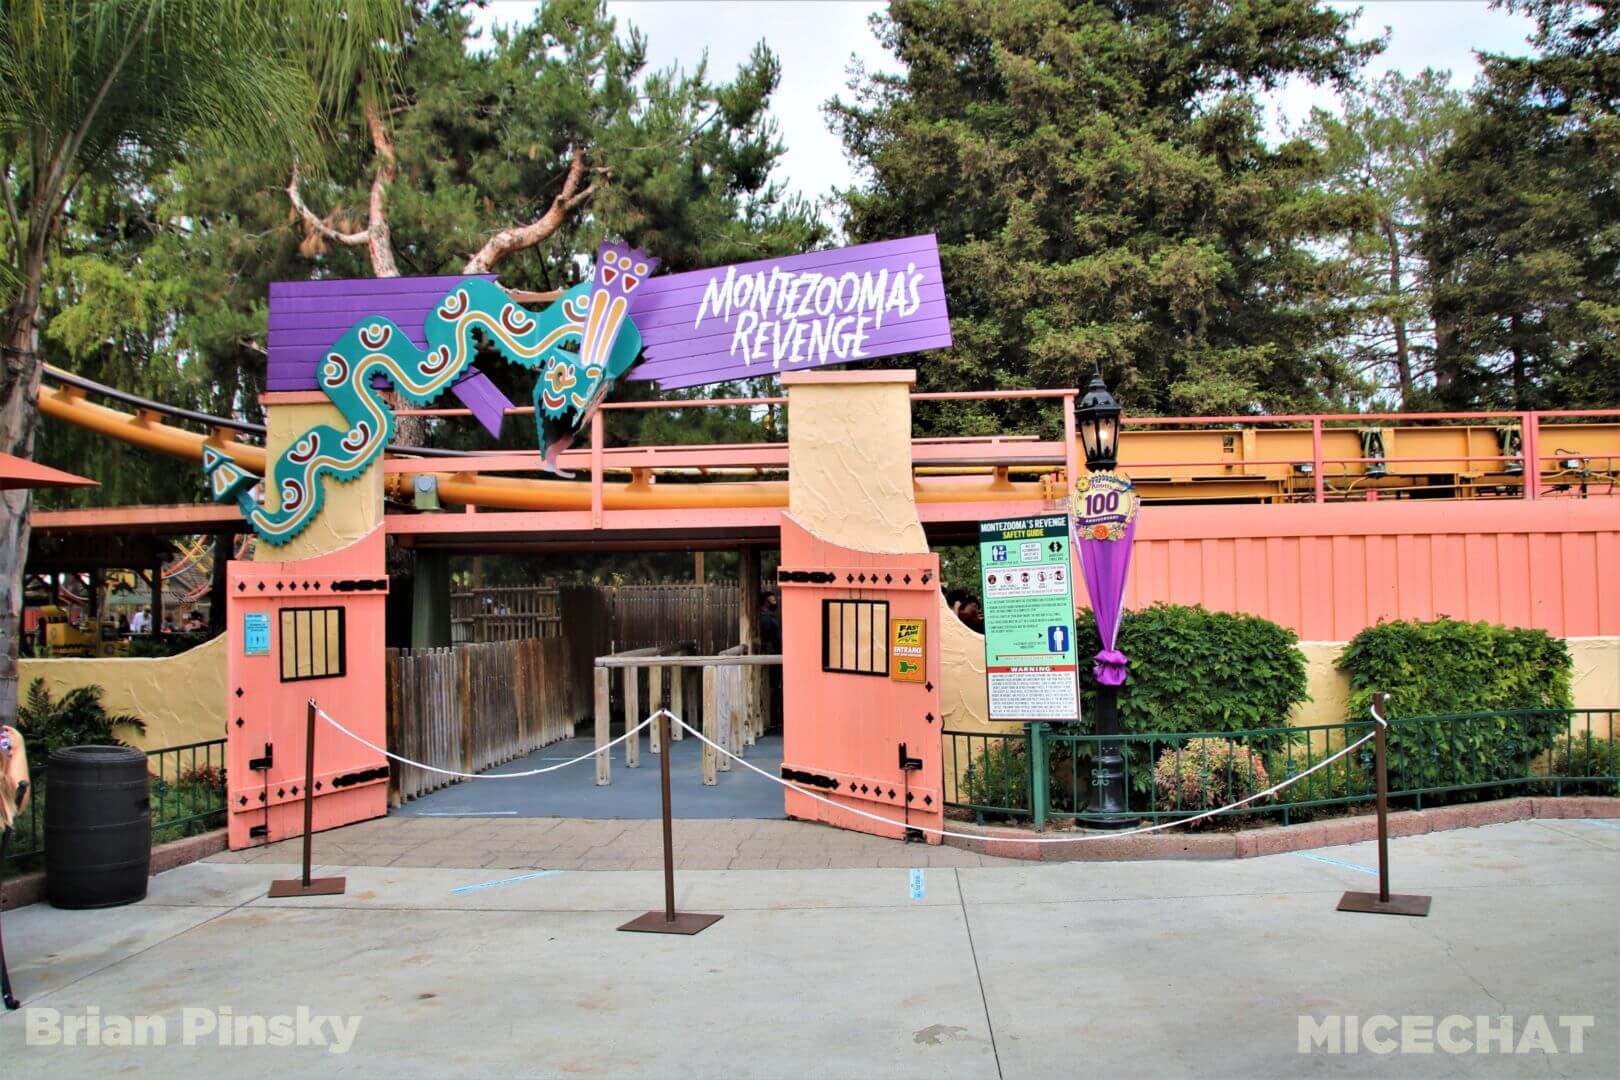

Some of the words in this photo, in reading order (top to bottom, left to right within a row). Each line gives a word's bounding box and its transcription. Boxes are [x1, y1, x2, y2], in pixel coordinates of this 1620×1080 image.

[695, 263, 924, 331] MONTEZOOMA'S
[730, 309, 874, 369] REVENGE
[1085, 491, 1119, 515] 100
[980, 519, 1034, 532] MONTEZOOMA'S
[1034, 517, 1067, 530] REVENGE
[1002, 530, 1025, 540] SAFETY
[1026, 528, 1045, 537] GUIDE
